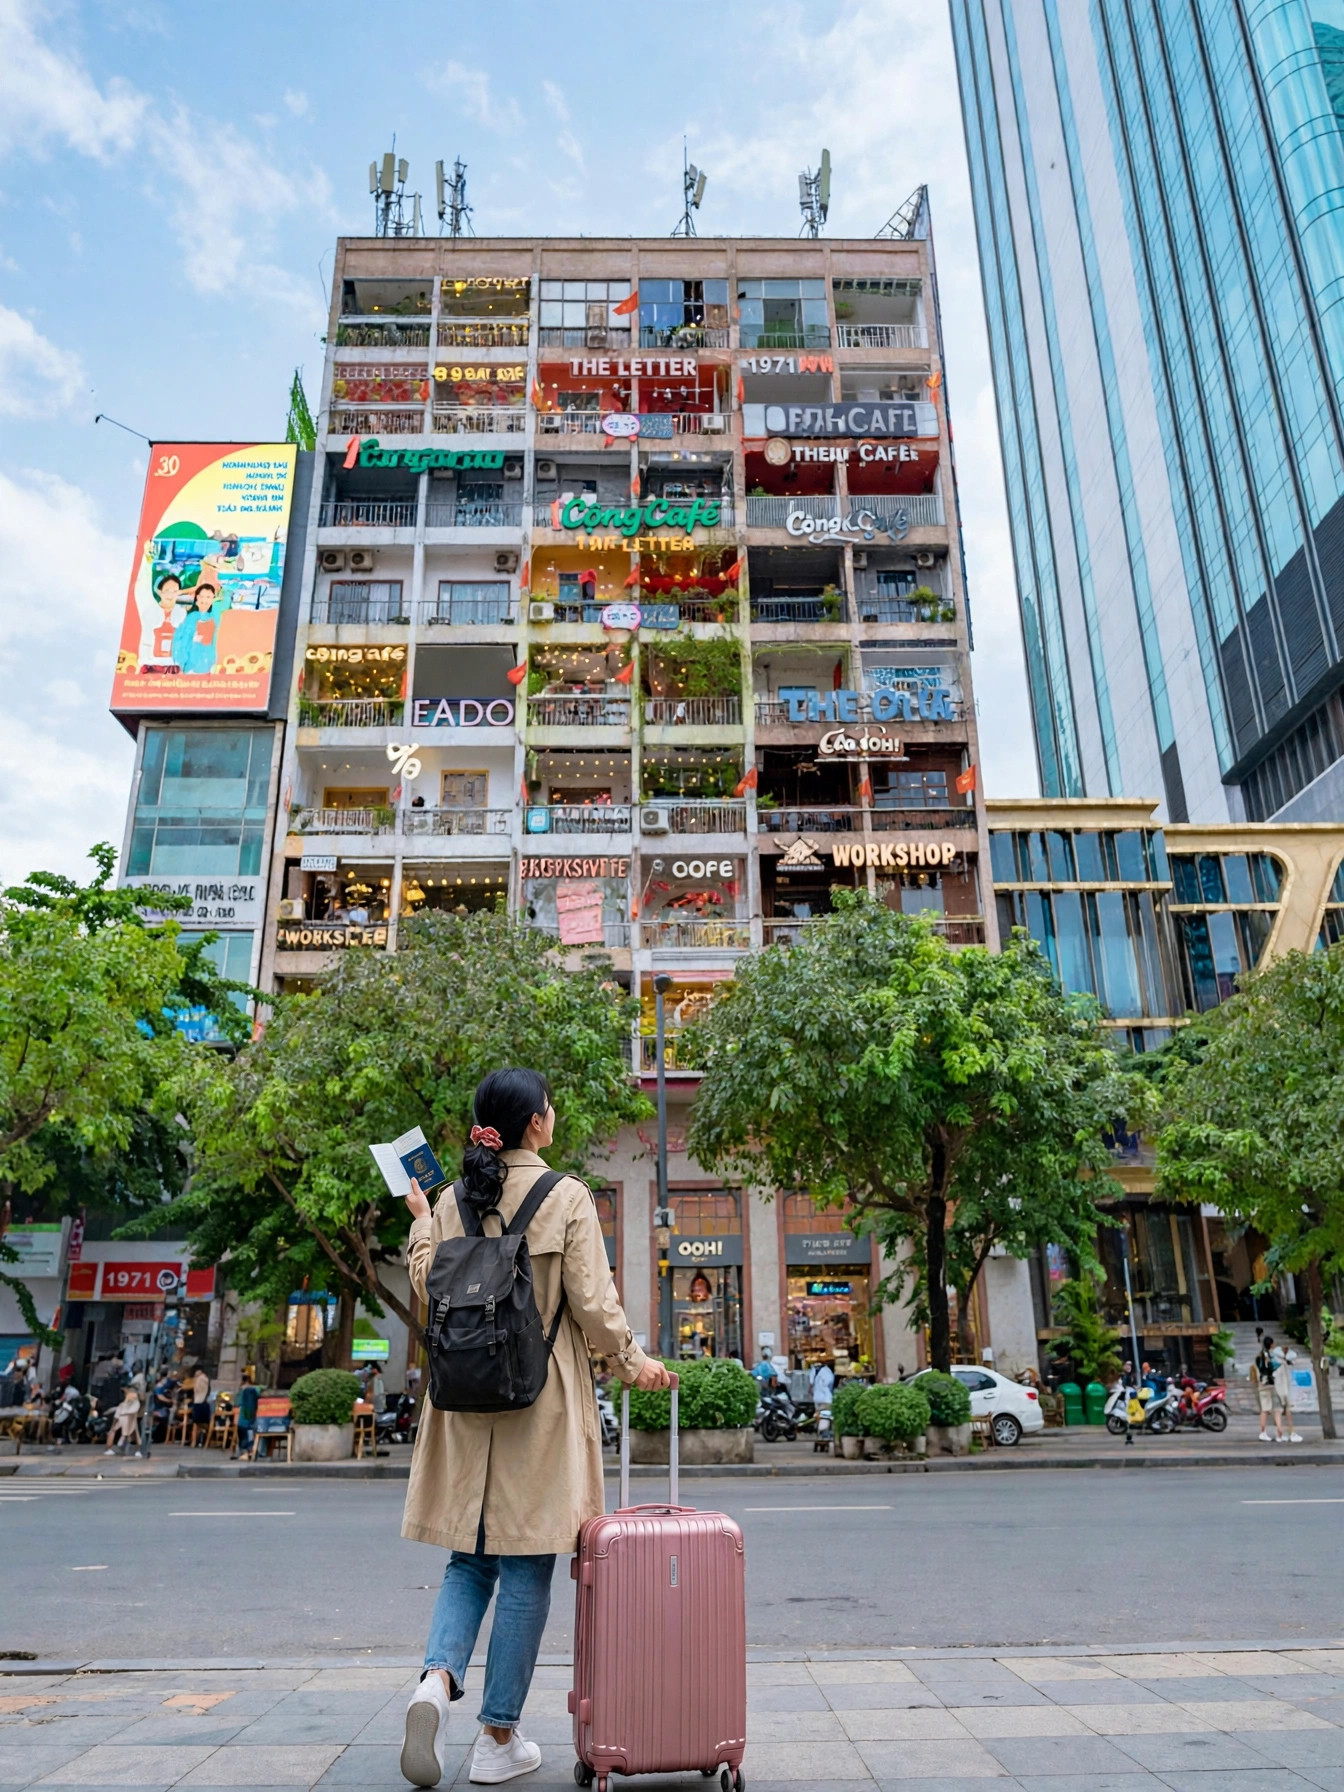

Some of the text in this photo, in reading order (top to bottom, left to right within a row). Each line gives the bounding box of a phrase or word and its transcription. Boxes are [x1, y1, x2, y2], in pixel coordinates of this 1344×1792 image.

[570, 358, 697, 376] THE LETTER
[749, 356, 795, 373] 1971
[154, 455, 180, 477] 30
[644, 498, 721, 534] Café
[412, 698, 515, 727] EADO
[778, 689, 859, 722] THE
[832, 842, 956, 867] WORKSHOP
[678, 1240, 723, 1256] OOH!
[106, 1271, 151, 1288] 1971
